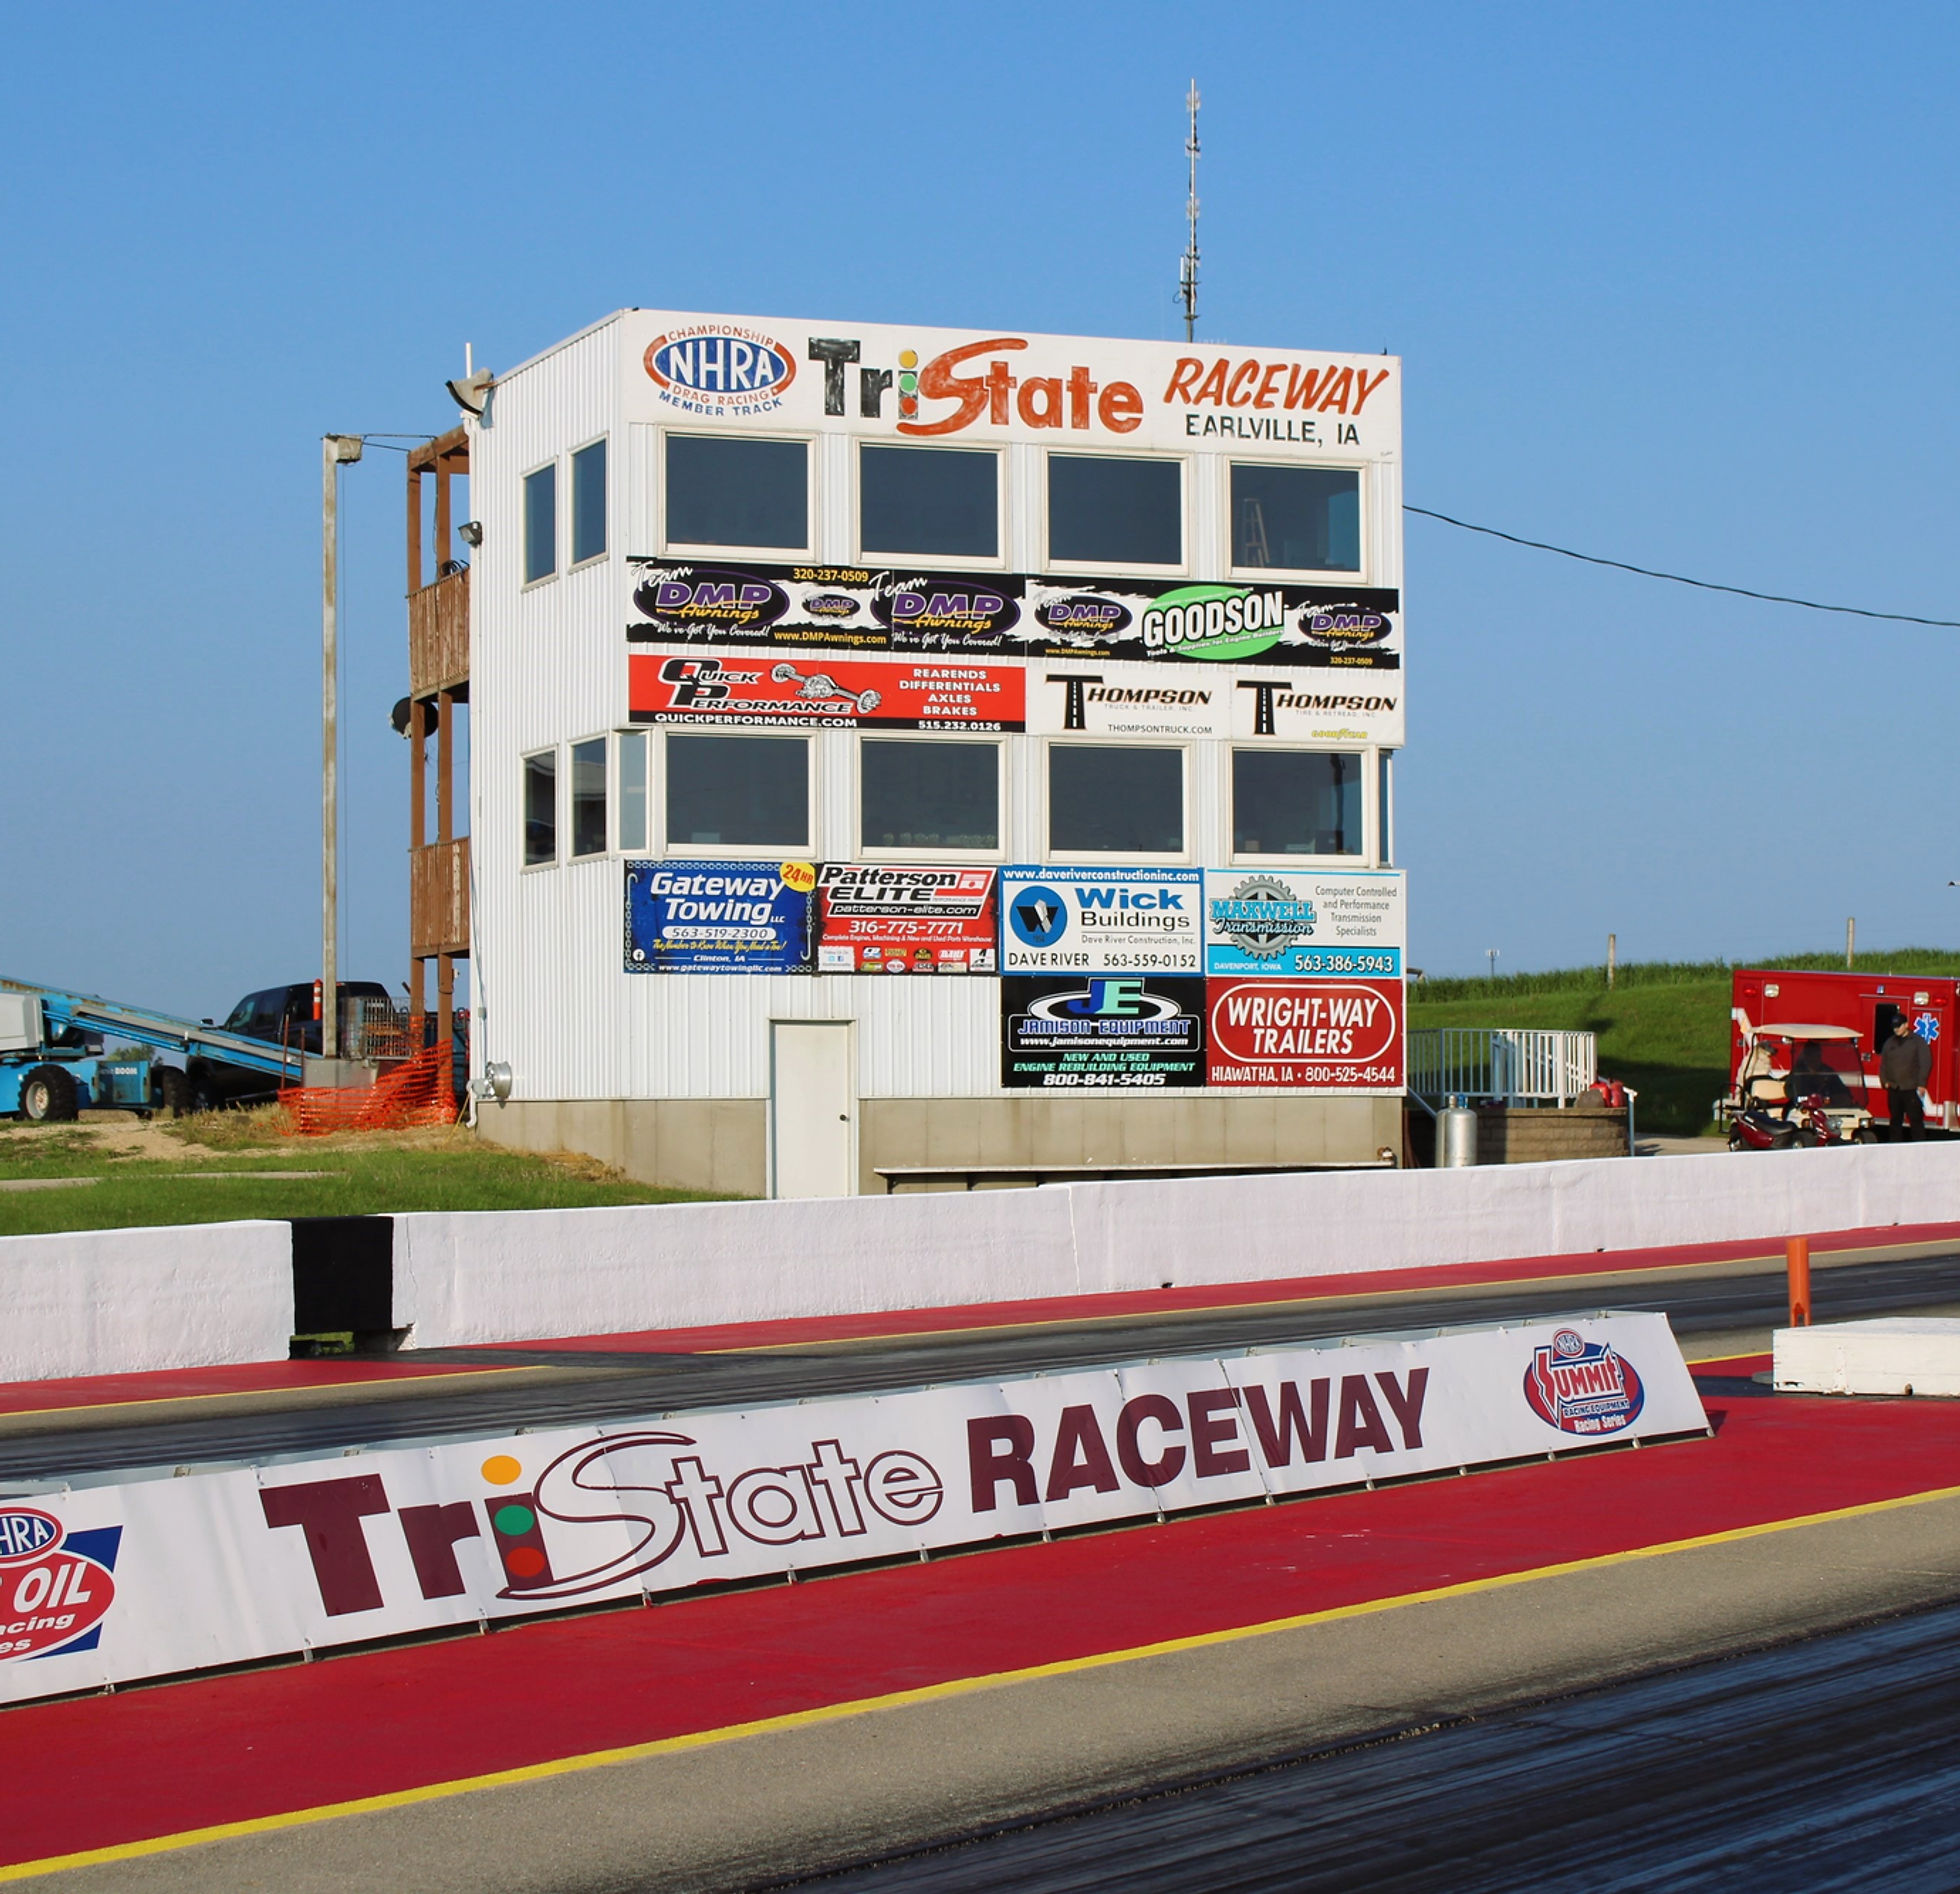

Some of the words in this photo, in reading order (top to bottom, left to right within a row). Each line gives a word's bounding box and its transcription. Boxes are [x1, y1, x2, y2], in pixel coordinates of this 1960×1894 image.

[669, 325, 774, 347] CHAMPIONSHIP
[669, 340, 775, 390] NHRA
[807, 337, 1144, 435] TriState
[1163, 356, 1390, 415] RACEWAY
[658, 391, 724, 416] MEMBER
[733, 397, 782, 416] TRACK
[673, 385, 710, 403] DRAG
[718, 390, 768, 405] RACING
[1186, 414, 1323, 446] EARLVILLE,
[1337, 420, 1360, 445] IA
[632, 561, 693, 592] Team
[793, 568, 869, 582] 320-237-0509
[868, 571, 928, 602] Team
[656, 582, 772, 610] DMP
[810, 598, 855, 611] DMP
[656, 602, 760, 625] Awnings
[891, 592, 1004, 620] DMP
[1048, 604, 1122, 623] DMP
[1298, 600, 1334, 621] Team
[892, 612, 992, 635] Awnings
[1143, 591, 1284, 648] GOODSON
[1311, 614, 1382, 632] DMP
[774, 632, 886, 645] www.DMPAwnings.com
[913, 669, 987, 680] REARENDS
[899, 680, 1001, 693] DIFFERENTIALS
[666, 683, 854, 714] PERFORMANCE
[928, 693, 972, 704] AXLES
[923, 705, 978, 716] BRAKES
[655, 713, 857, 727] QUICKPERFORMANCE.COM
[918, 720, 1001, 732] 515.232.0126
[1108, 723, 1213, 735] THOMPSONTRUCK.COM
[821, 866, 957, 886] Patterson
[1003, 868, 1200, 882] www.daveriverconstructioninc.com
[650, 872, 786, 900] Gateway
[829, 887, 935, 902] ELITE
[1315, 886, 1354, 898] Computer
[1356, 886, 1397, 898] Controlled
[1075, 888, 1184, 910] Wick
[1323, 900, 1337, 909] and
[1340, 901, 1390, 911] Performance
[665, 898, 773, 925] Towing
[834, 904, 977, 915] patterson-elite.com
[1210, 900, 1316, 922] MAXWELL
[1331, 912, 1382, 923] Transmission
[848, 920, 964, 935] 316-775-7771
[1081, 911, 1191, 932] Buildings
[1214, 917, 1314, 936] Transmission
[672, 927, 768, 939] 563-519-2300
[1081, 935, 1103, 945] Dave
[1104, 935, 1126, 945] River
[1127, 935, 1181, 946] Construction,
[1181, 936, 1196, 945] Inc.
[1336, 925, 1377, 938] Specialists
[1009, 952, 1046, 966] DAVE
[1050, 953, 1089, 966] RIVER
[1103, 953, 1197, 968] 563-559-0152
[1295, 955, 1394, 972] 563-386-5943
[1066, 980, 1142, 1015] JE
[1228, 997, 1380, 1028] WRIGHT-WAY
[1018, 1020, 1092, 1035] JAMISON
[1098, 1020, 1192, 1035] EQUIPMENT
[1020, 1036, 1188, 1047] www.jamisonequipment.com
[1254, 1028, 1354, 1055] TRAILERS
[1063, 1053, 1089, 1062] NEW
[1091, 1053, 1117, 1062] AND
[1120, 1053, 1150, 1062] USED
[1013, 1063, 1056, 1072] ENGINE
[1058, 1063, 1127, 1072] REBUILDING
[1130, 1063, 1196, 1072] EQUIPMENT
[1281, 1066, 1294, 1082] IA
[1305, 1066, 1395, 1082] 800-525-4544
[1043, 1073, 1167, 1086] 800-841-5405
[1564, 1405, 1591, 1418] RACING
[1591, 1400, 1630, 1414] EQUIPMENT
[1574, 1418, 1601, 1433] Racing
[1601, 1414, 1627, 1430] Series
[967, 1367, 1430, 1513] RACEWAY
[259, 1431, 944, 1617] TriState
[14, 1562, 92, 1613] OIL
